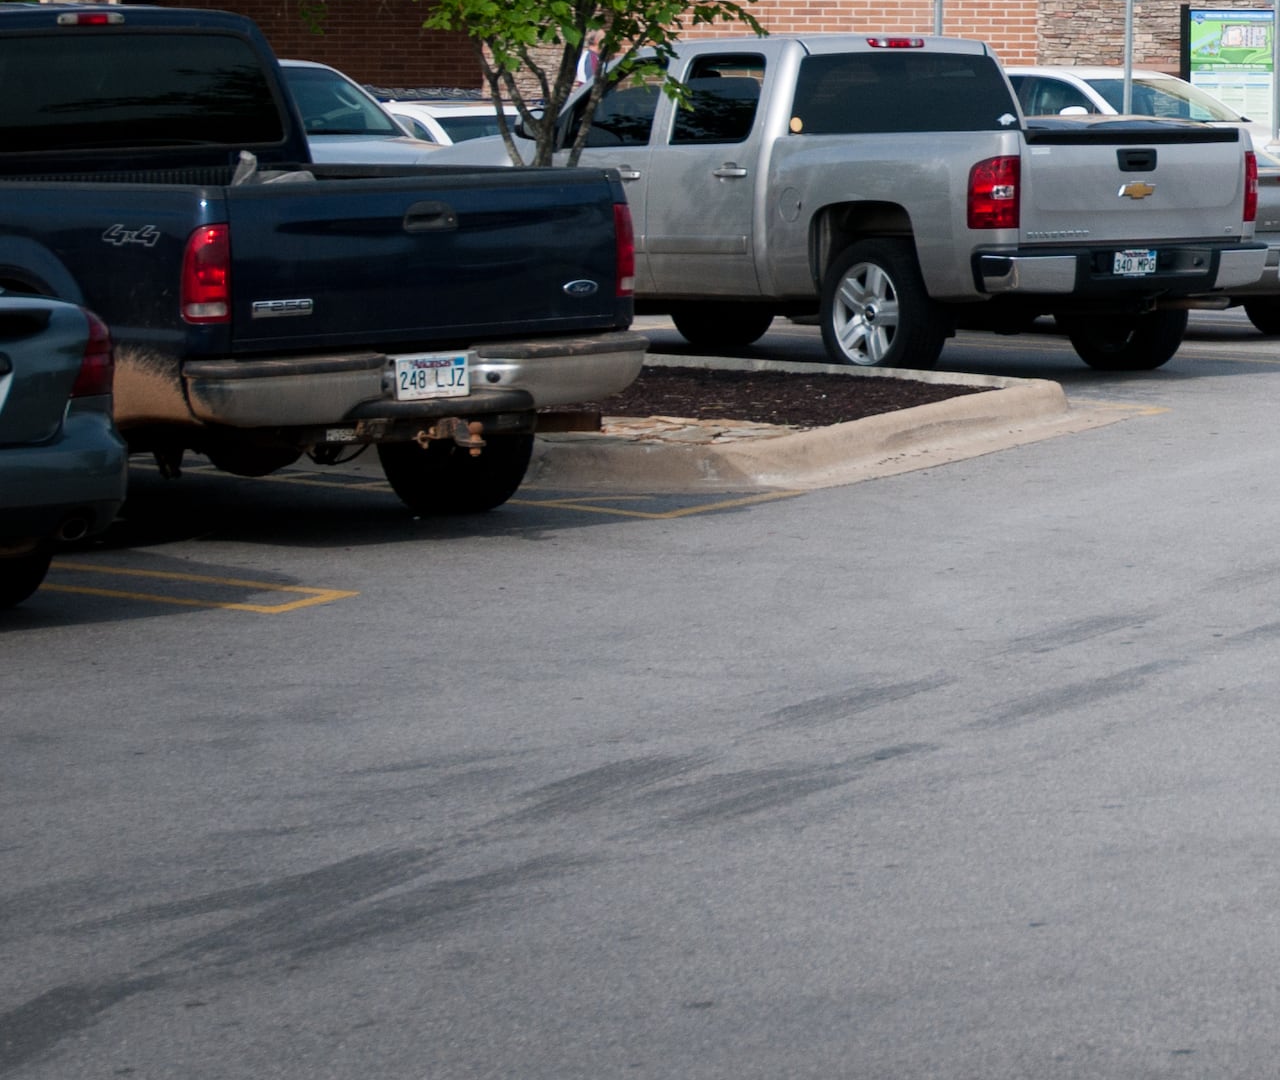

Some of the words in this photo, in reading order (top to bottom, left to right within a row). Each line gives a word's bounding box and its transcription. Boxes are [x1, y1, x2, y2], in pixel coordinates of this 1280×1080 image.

[102, 223, 160, 247] 4x4
[1114, 258, 1133, 273] 340
[400, 370, 426, 391] 248
[435, 367, 465, 388] LJZ
